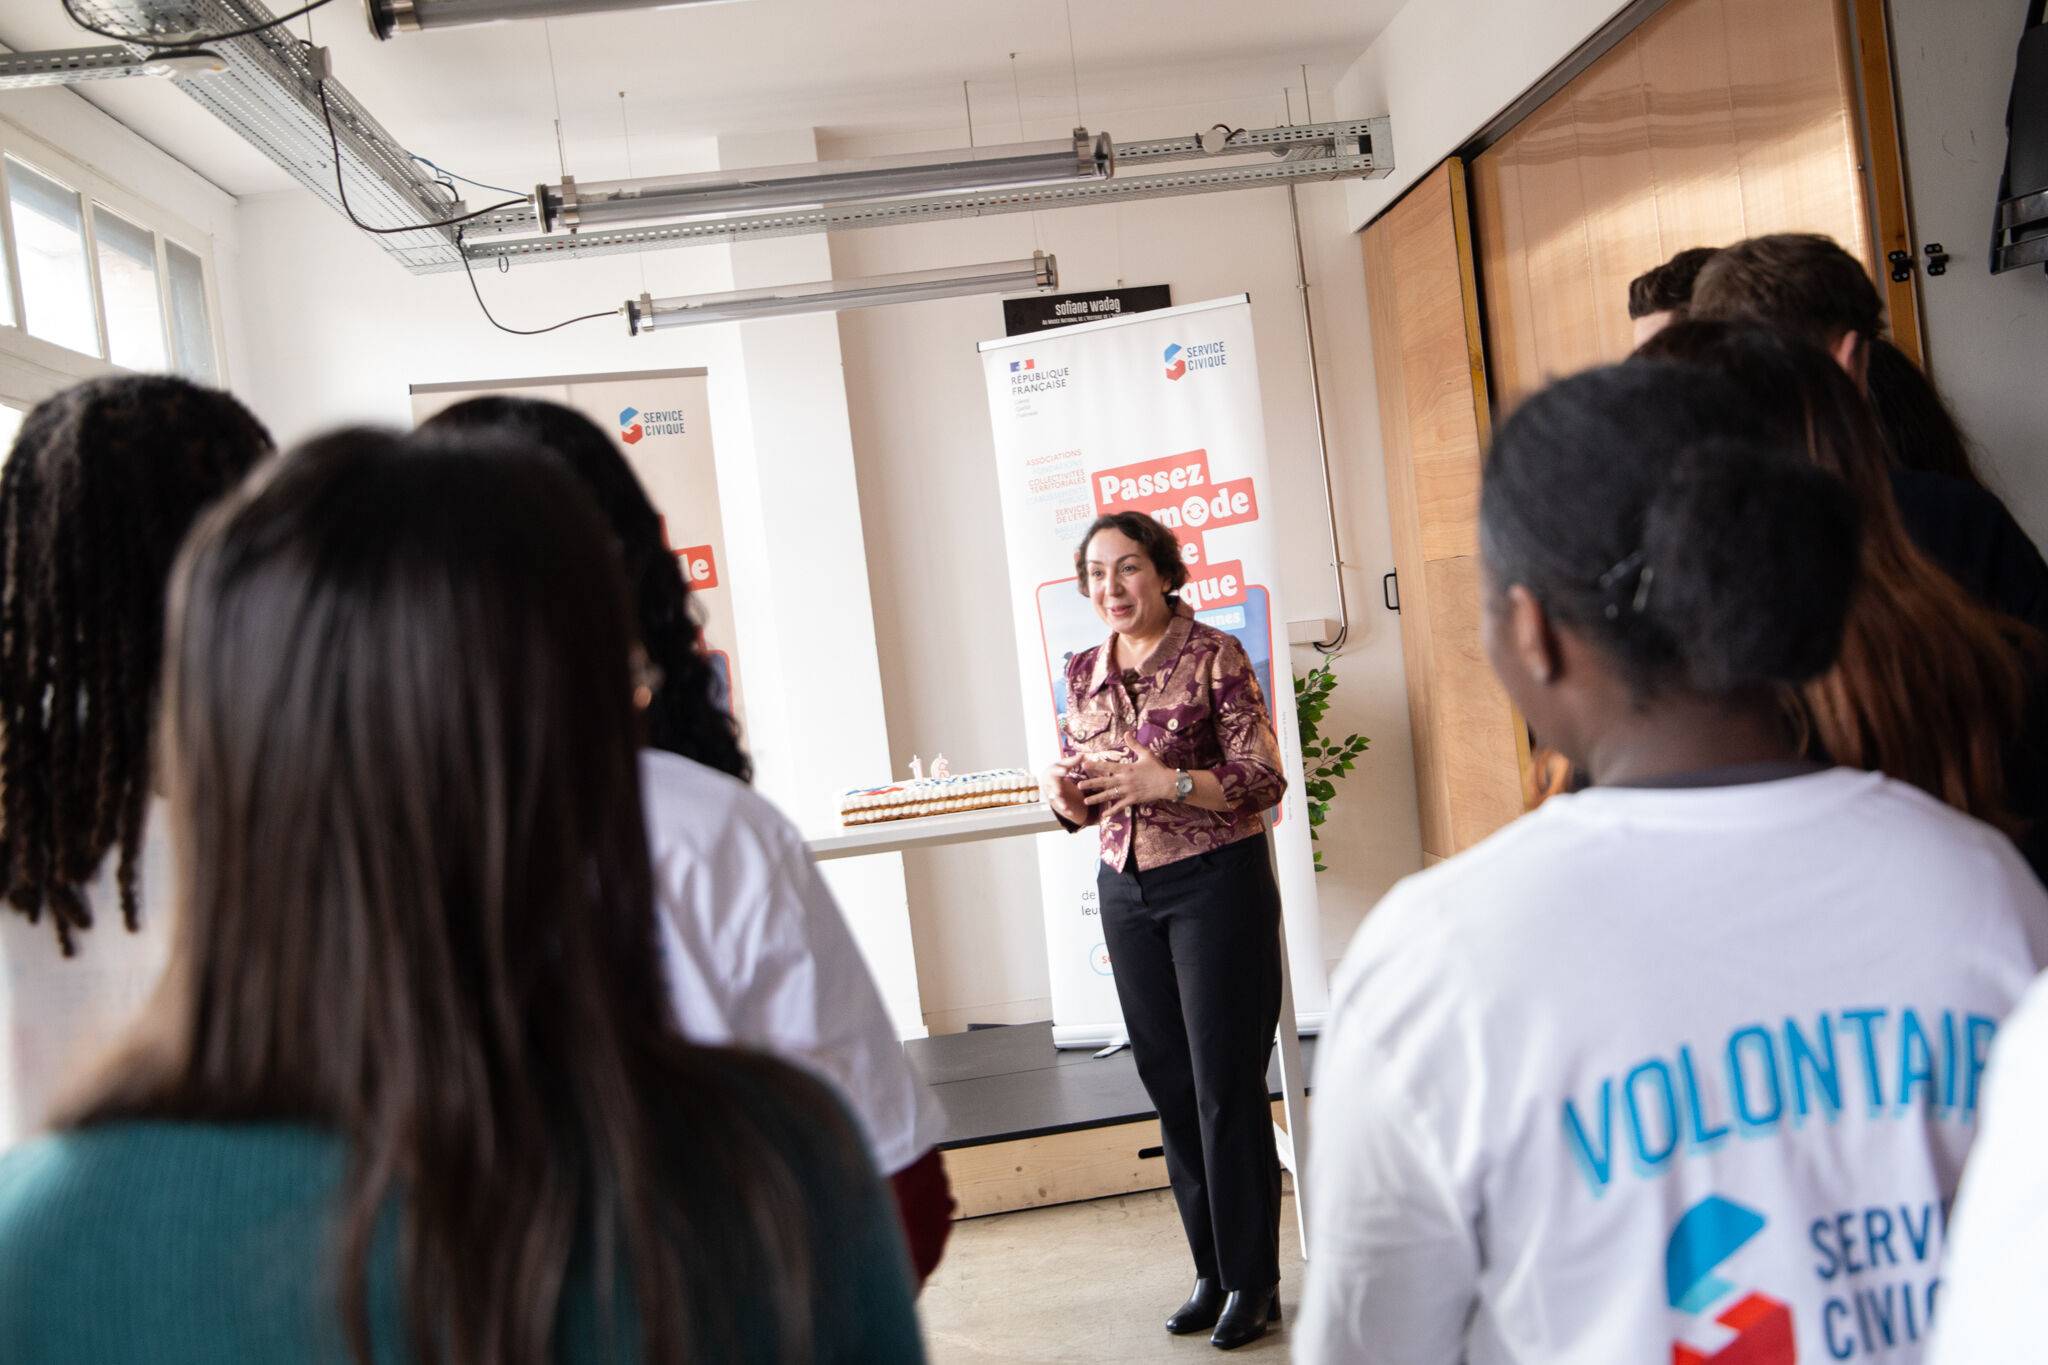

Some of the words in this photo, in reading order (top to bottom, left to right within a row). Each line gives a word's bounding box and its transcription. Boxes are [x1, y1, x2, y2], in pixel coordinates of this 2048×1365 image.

[1055, 300, 1088, 315] sofiane
[1187, 341, 1225, 358] SERVICE
[1188, 354, 1227, 371] CIVIQUE
[1012, 379, 1067, 395] FRANÇAISE
[643, 410, 685, 423] SERVICE
[644, 422, 686, 436] CIVIQUE
[1026, 448, 1083, 466] ASSOCIATIONS
[1099, 463, 1204, 504] Passez
[1055, 503, 1091, 517] SERVICES
[1081, 890, 1096, 901] de
